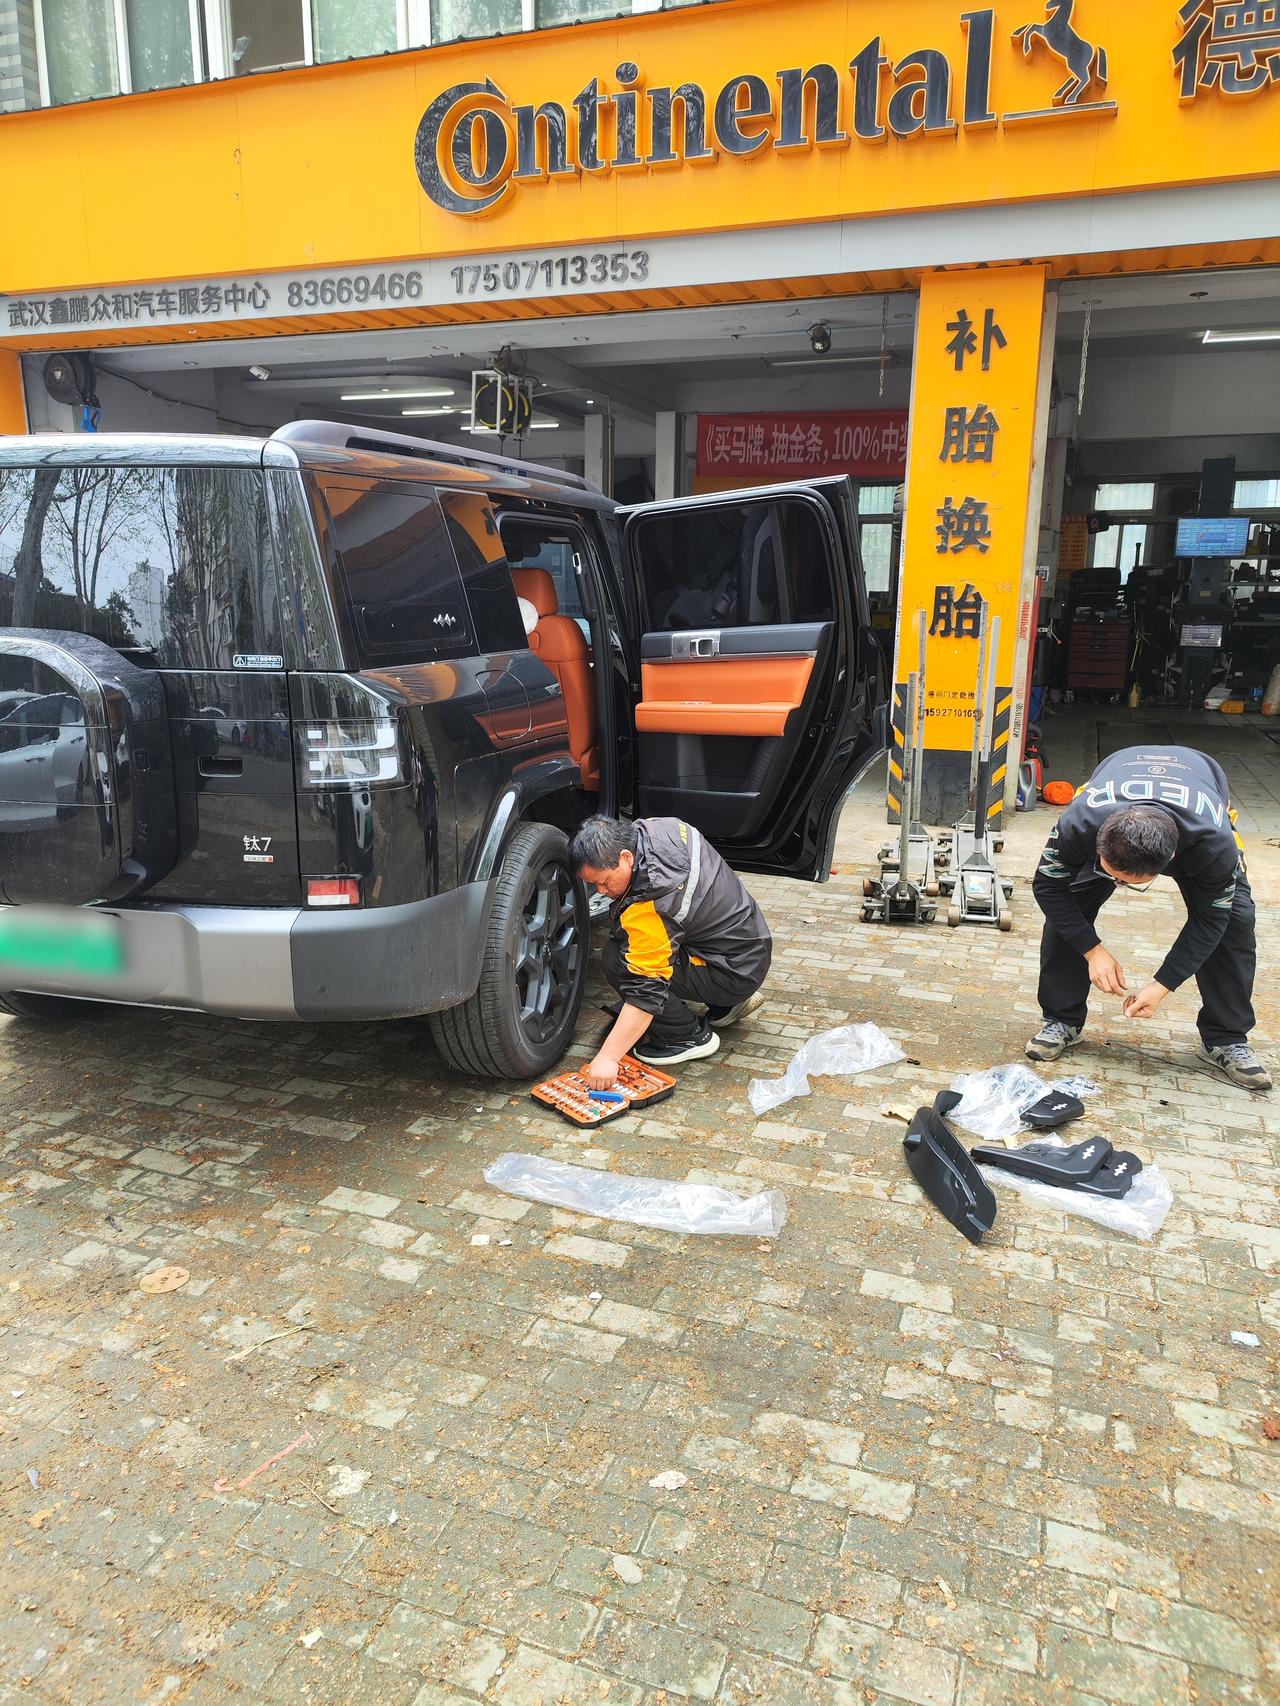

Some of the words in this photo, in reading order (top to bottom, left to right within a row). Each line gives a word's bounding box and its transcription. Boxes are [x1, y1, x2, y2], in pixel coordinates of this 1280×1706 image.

[1171, 0, 1280, 98] 德
[414, 8, 996, 215] Continental
[7, 281, 271, 328] 武汉鑫鹏众和汽车服务中心
[287, 271, 423, 308] 83669466
[450, 250, 650, 296] 17507113353
[243, 835, 272, 852] 钛7
